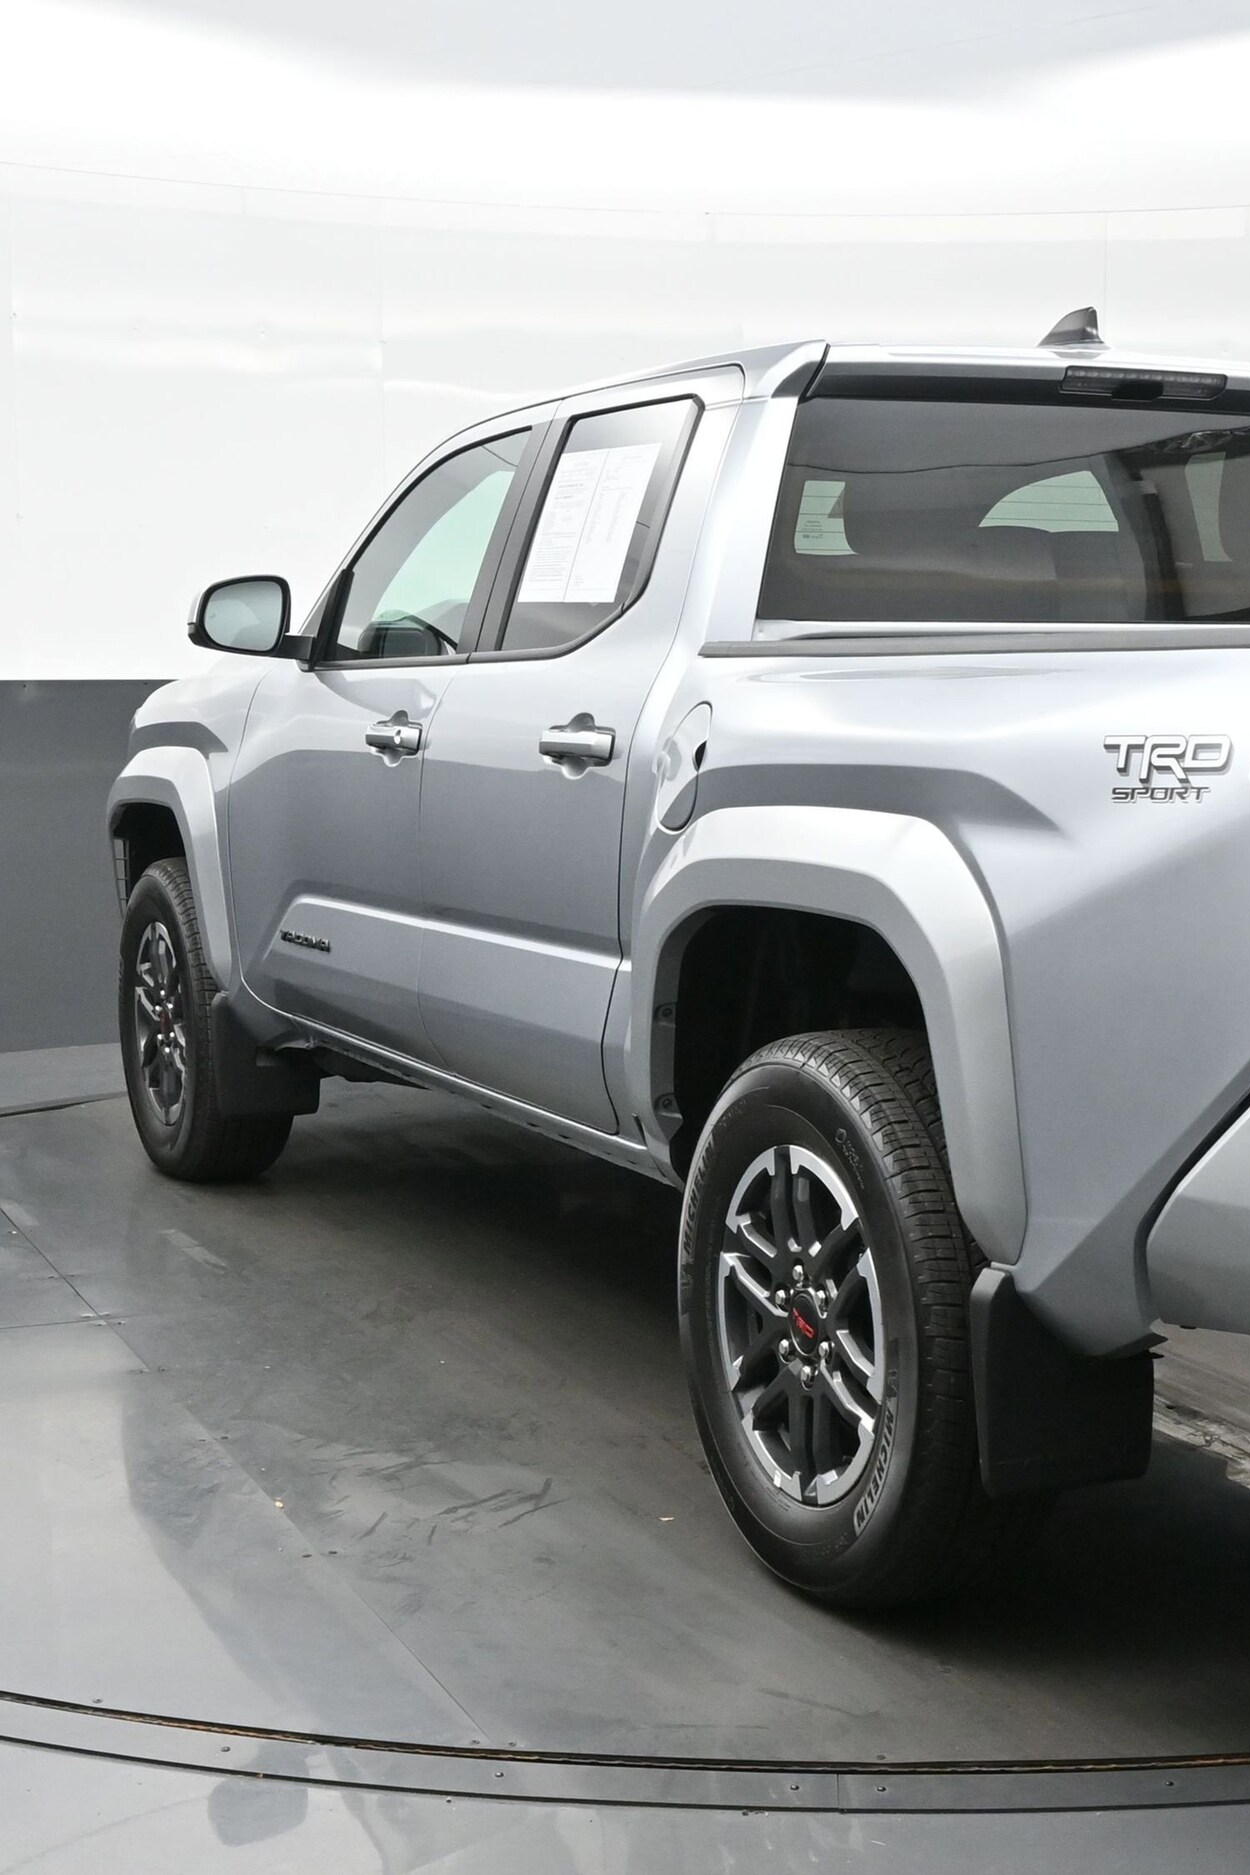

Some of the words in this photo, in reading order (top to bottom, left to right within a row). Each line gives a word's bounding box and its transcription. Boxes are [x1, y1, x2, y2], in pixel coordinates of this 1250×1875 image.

[1103, 734, 1232, 784] TRD
[1111, 786, 1210, 802] SPORT
[855, 1408, 895, 1528] MICHELIN
